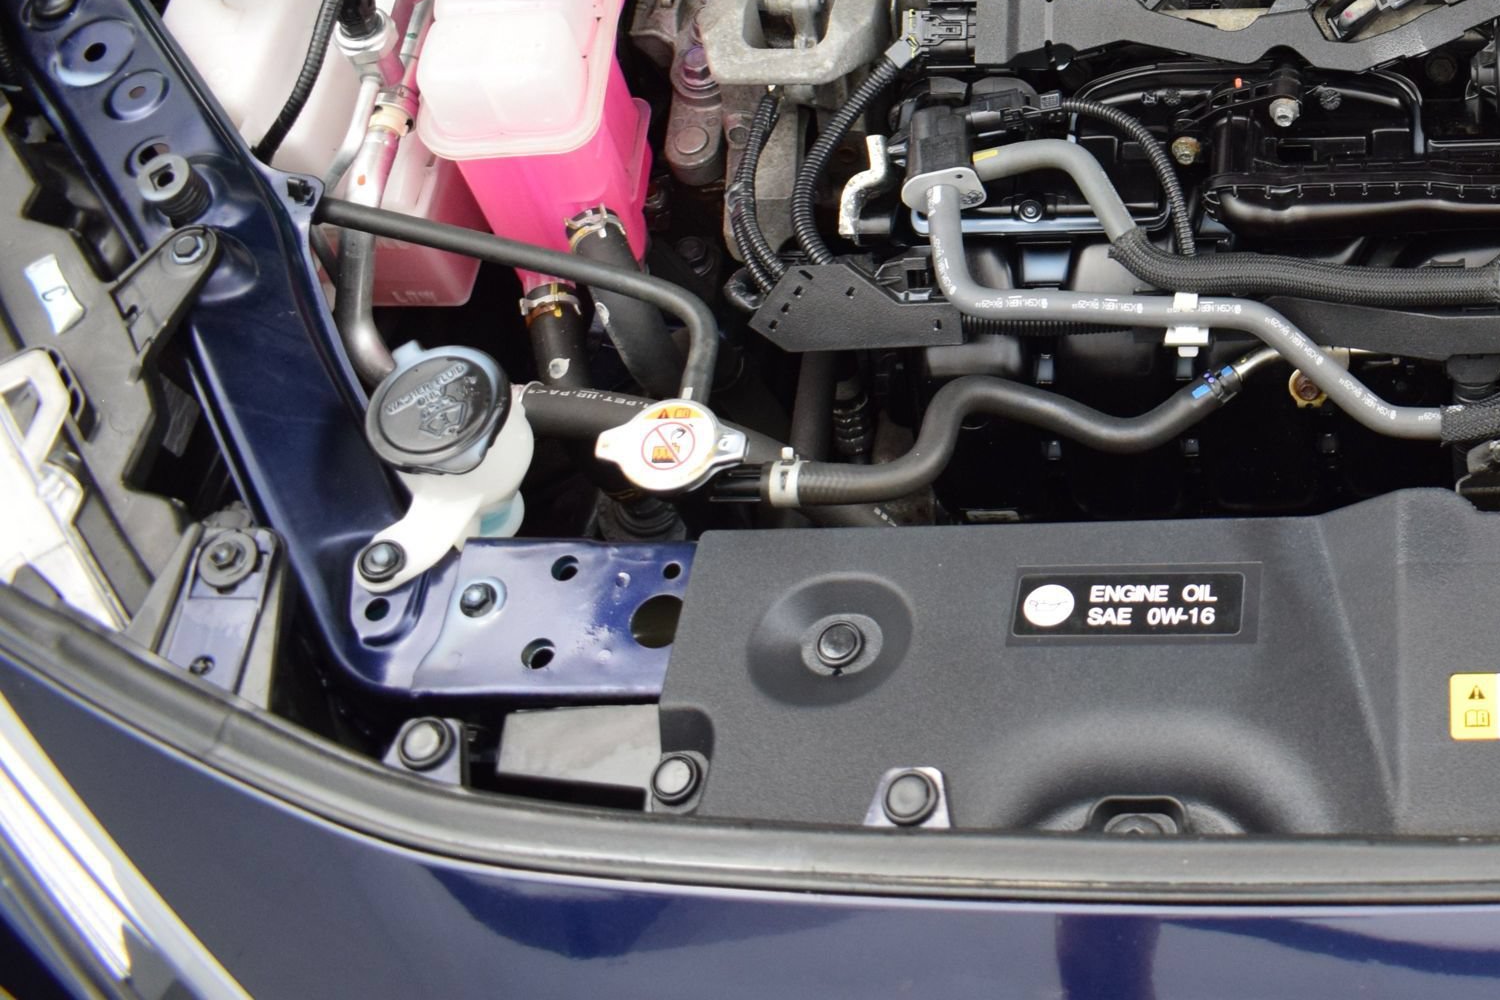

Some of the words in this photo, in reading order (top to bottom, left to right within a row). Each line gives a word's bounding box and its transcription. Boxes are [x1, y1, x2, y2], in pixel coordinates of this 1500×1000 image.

[435, 361, 469, 386] FLUID
[1089, 583, 1170, 603] ENGINE
[1182, 583, 1218, 602] OIL
[1087, 607, 1133, 626] SAE
[1147, 607, 1216, 626] 0W-16
